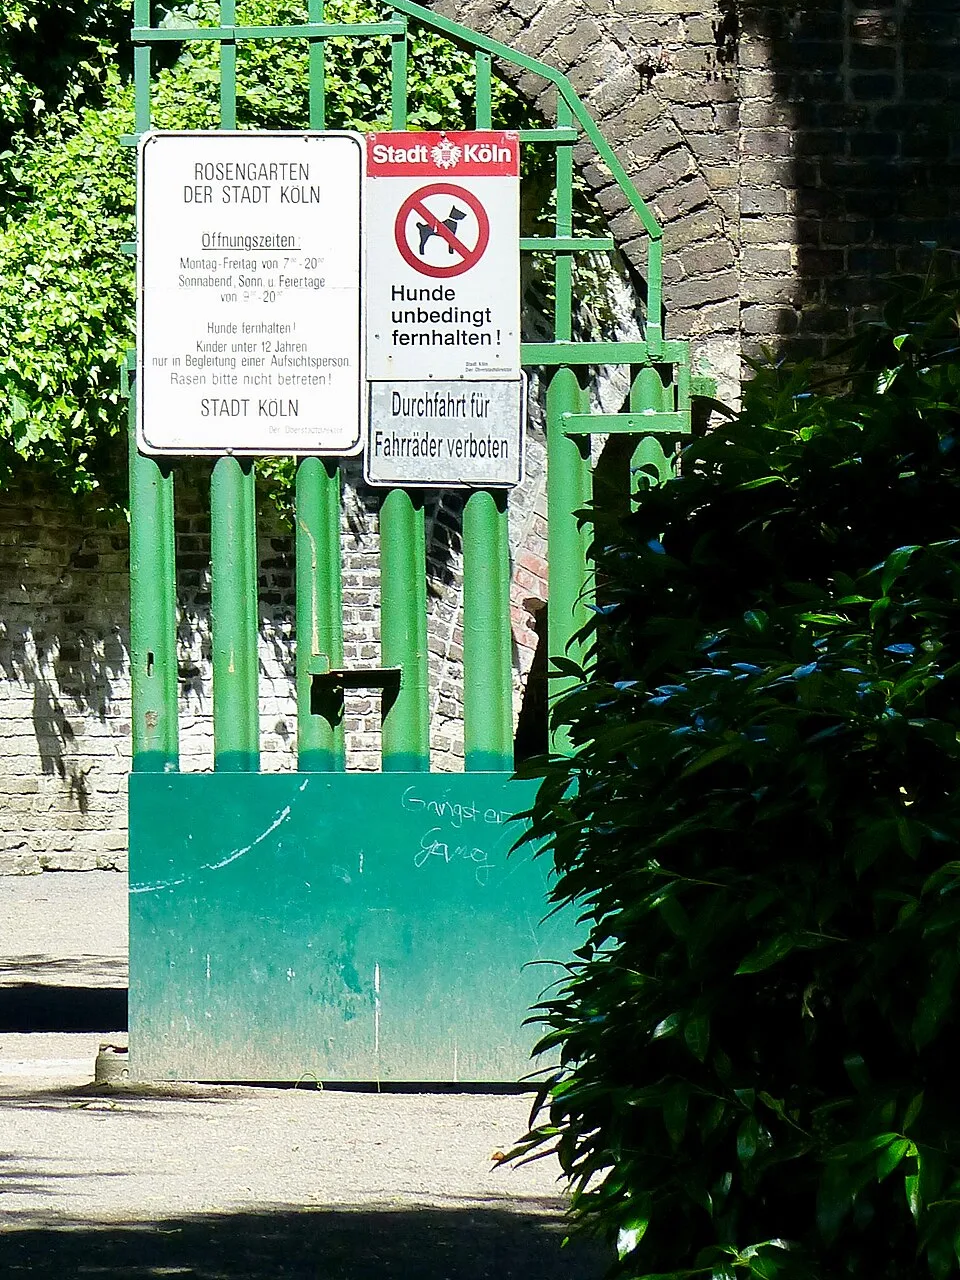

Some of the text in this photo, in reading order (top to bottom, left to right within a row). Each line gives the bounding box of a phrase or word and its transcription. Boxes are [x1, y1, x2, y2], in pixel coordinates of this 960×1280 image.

[372, 142, 512, 163] Stadt Köln
[195, 163, 309, 181] ROSENGARTEN
[184, 185, 320, 203] DER STADT KÖLN
[262, 260, 278, 269] von
[279, 275, 325, 290] Feiertage
[221, 293, 237, 302] von
[392, 285, 455, 301] Hunde
[392, 307, 491, 327] unbedingt
[208, 322, 237, 334] Hunde
[197, 341, 307, 352] Kinder unter 12 Jahren
[153, 358, 168, 366] nur
[173, 358, 180, 366] in
[186, 355, 236, 369] Begleitung
[242, 357, 265, 366] einer
[171, 373, 331, 385] Rasen bitte nicht betreten!
[201, 399, 298, 417] STADT KÖLN
[392, 391, 490, 418] Durchfahrt für
[375, 431, 509, 459] Fahrräder verboten
